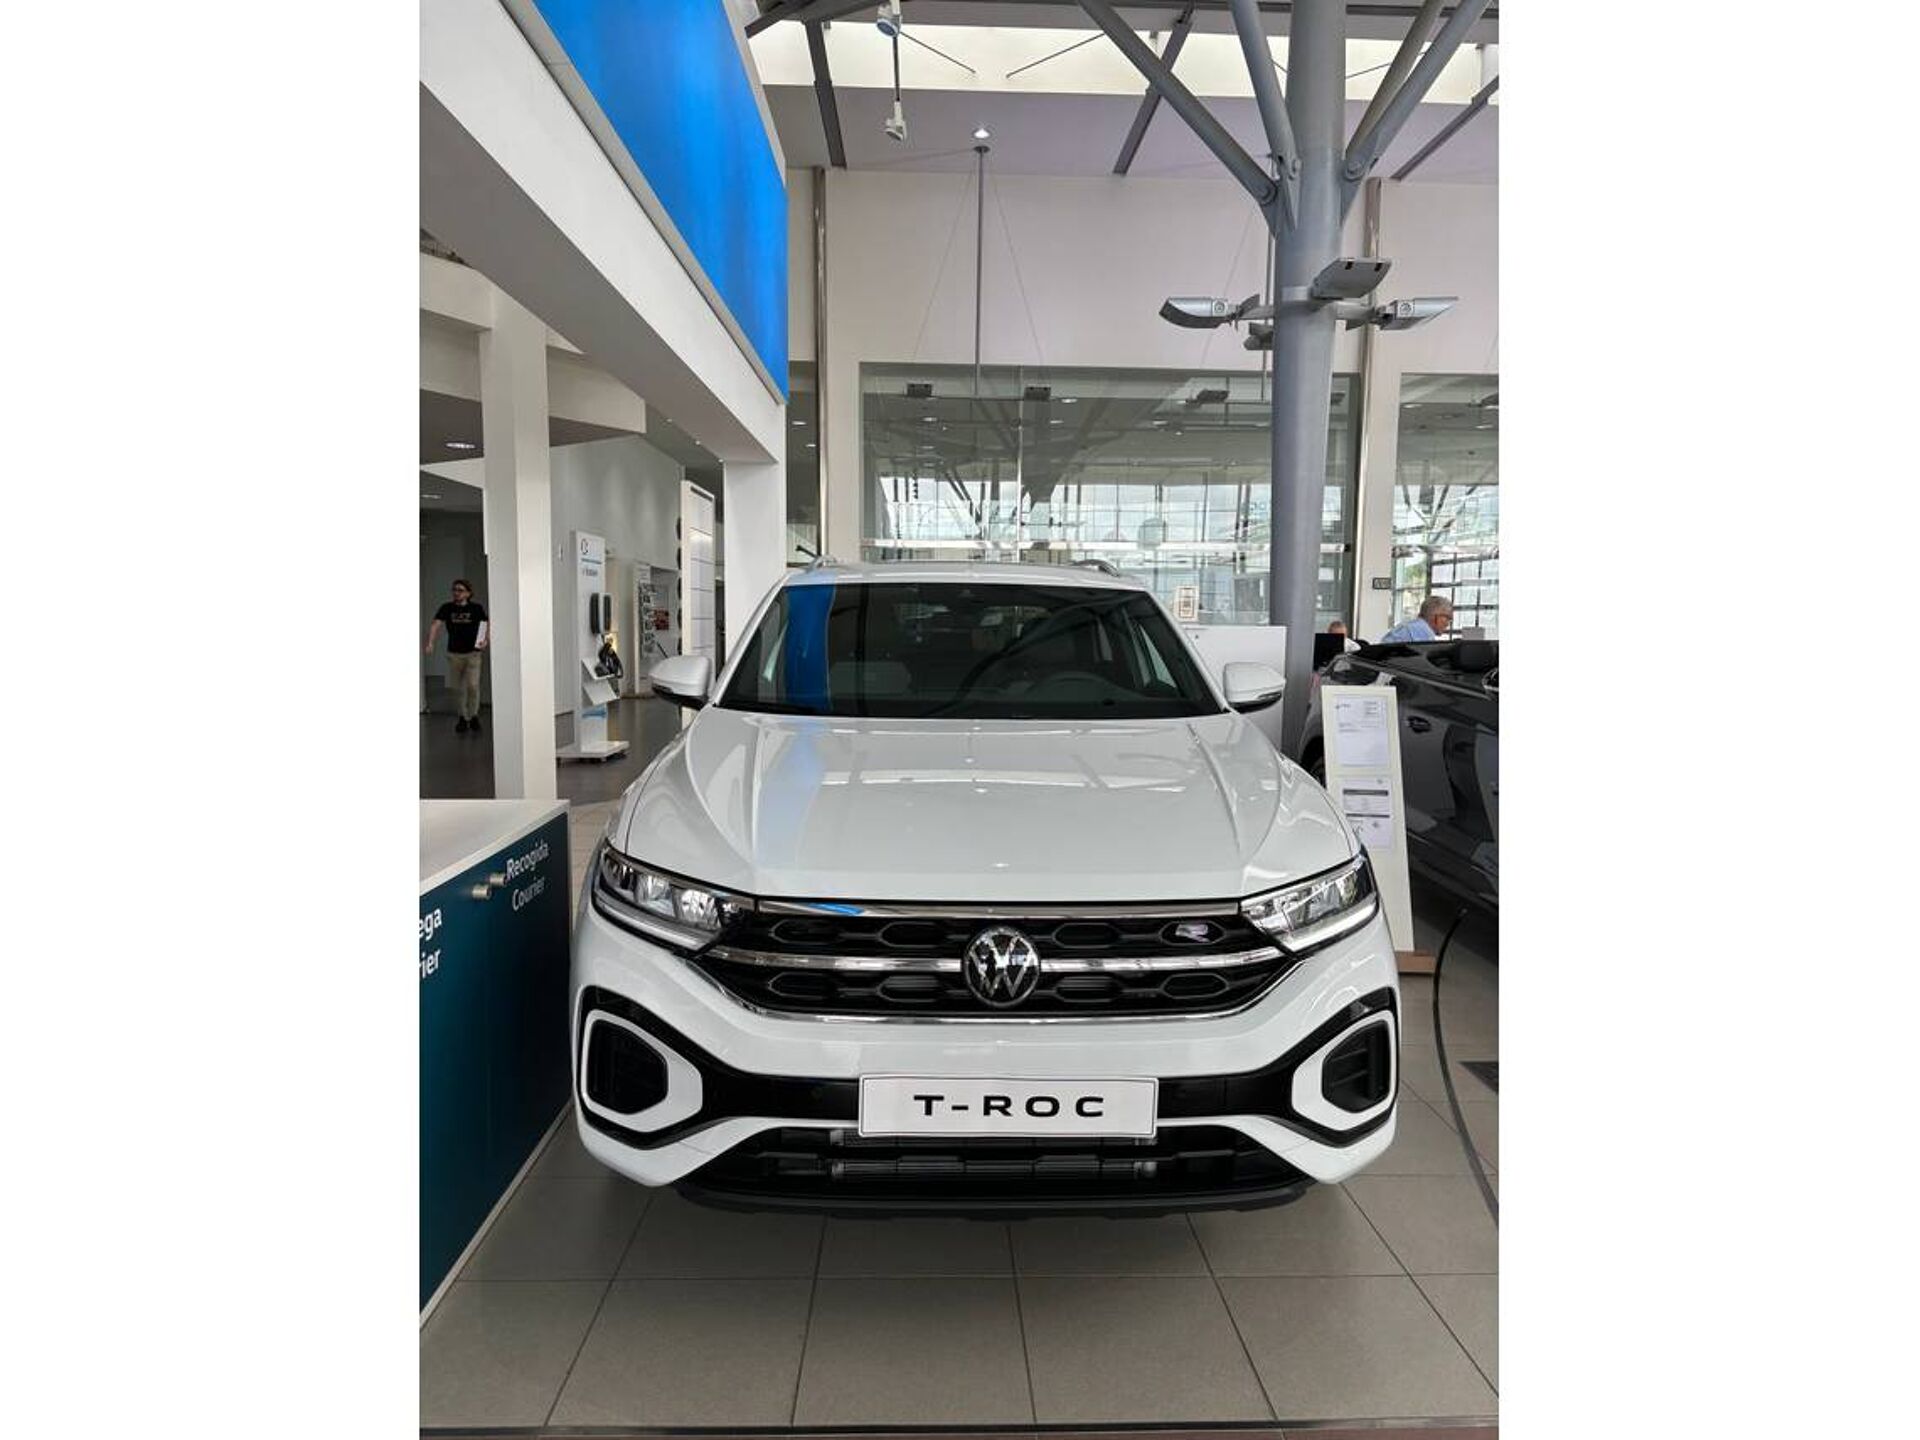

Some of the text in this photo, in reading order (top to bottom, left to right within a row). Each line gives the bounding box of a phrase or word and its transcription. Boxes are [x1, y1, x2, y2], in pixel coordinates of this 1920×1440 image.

[506, 839, 549, 880] Recogida
[512, 876, 545, 911] Courier
[419, 949, 441, 978] ier
[913, 1095, 1104, 1117] T-ROC
